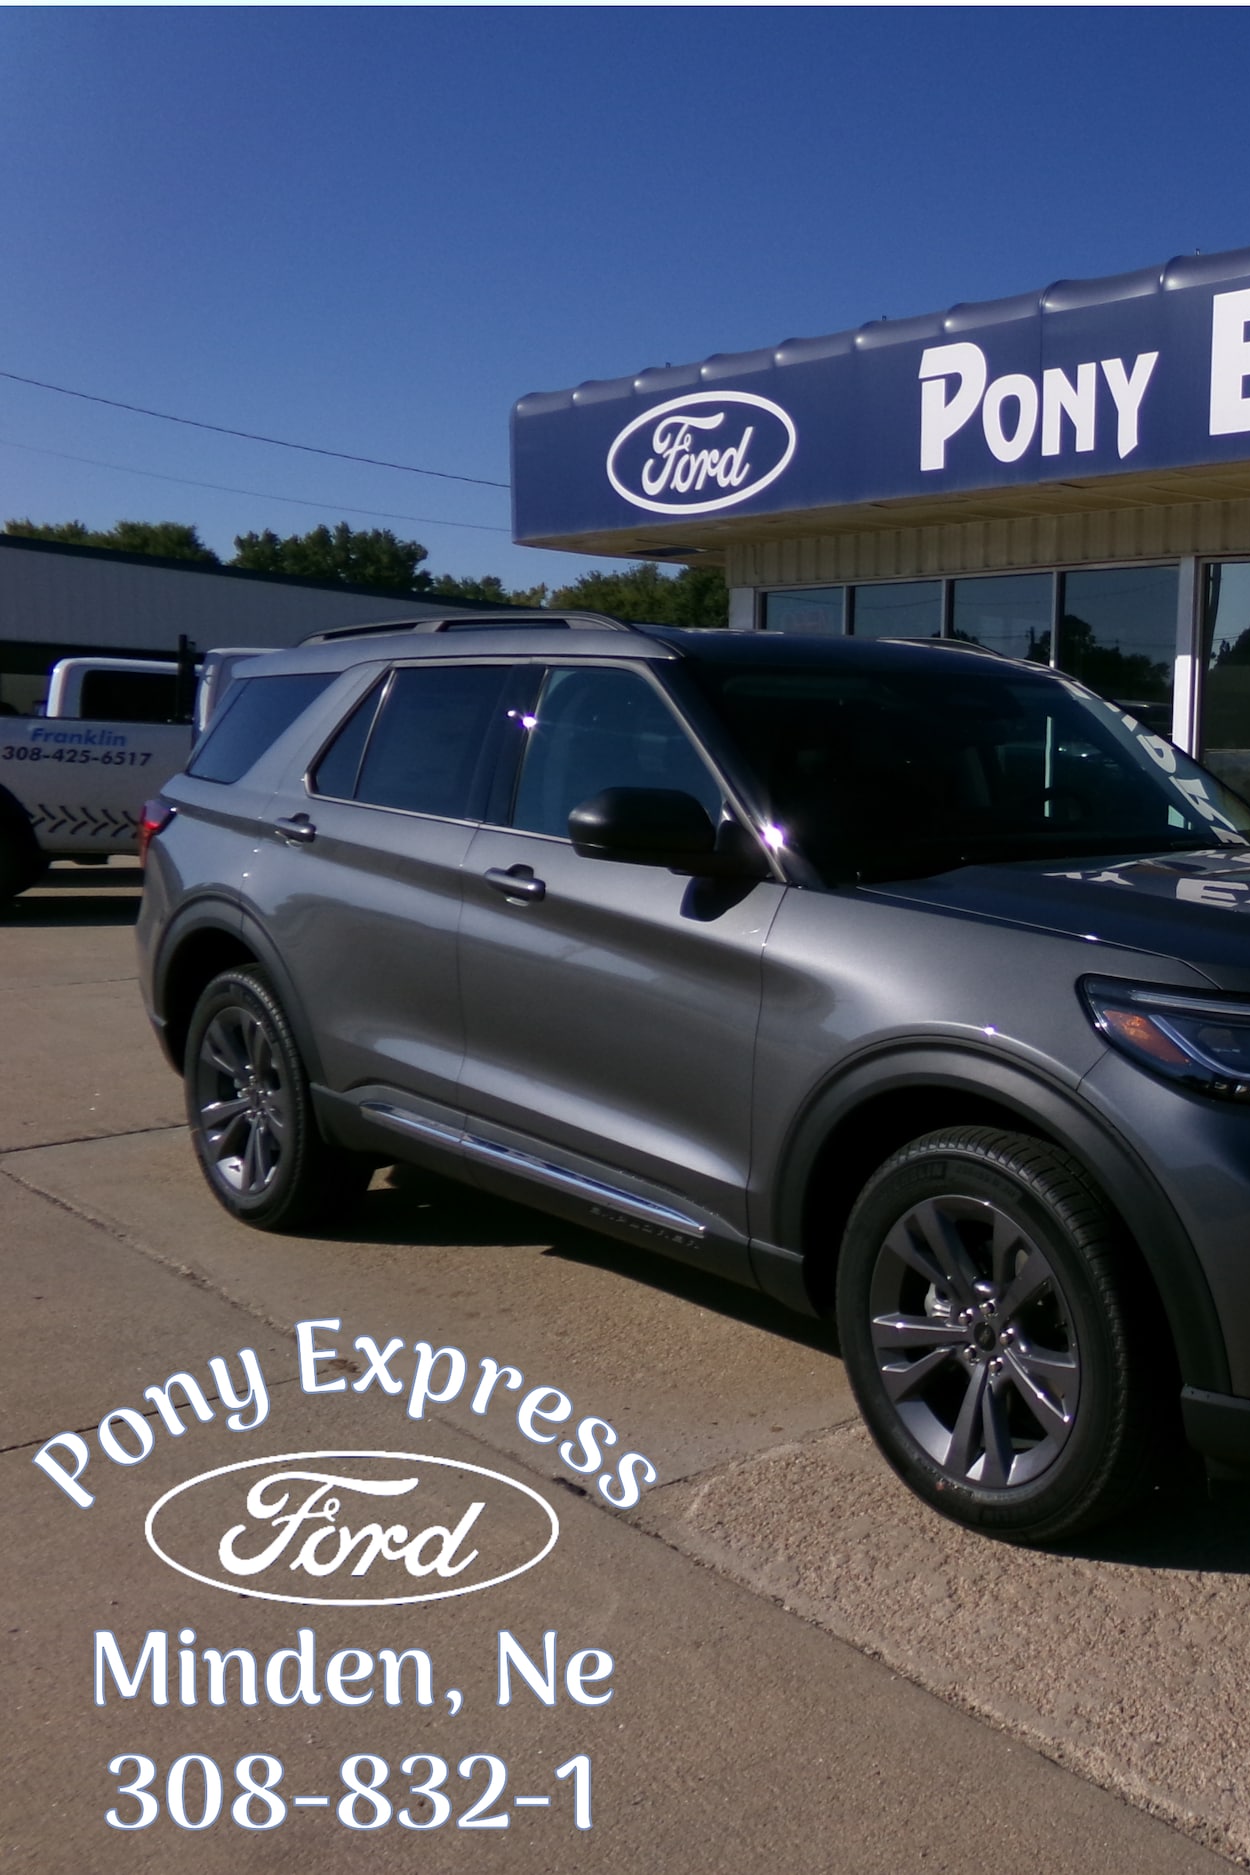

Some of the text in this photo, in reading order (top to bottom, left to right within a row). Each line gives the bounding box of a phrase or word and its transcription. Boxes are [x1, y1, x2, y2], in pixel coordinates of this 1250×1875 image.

[918, 341, 1159, 472] PONY
[641, 413, 753, 496] Ford
[2, 746, 152, 766] 308-425-6517
[31, 728, 127, 746] Franklin
